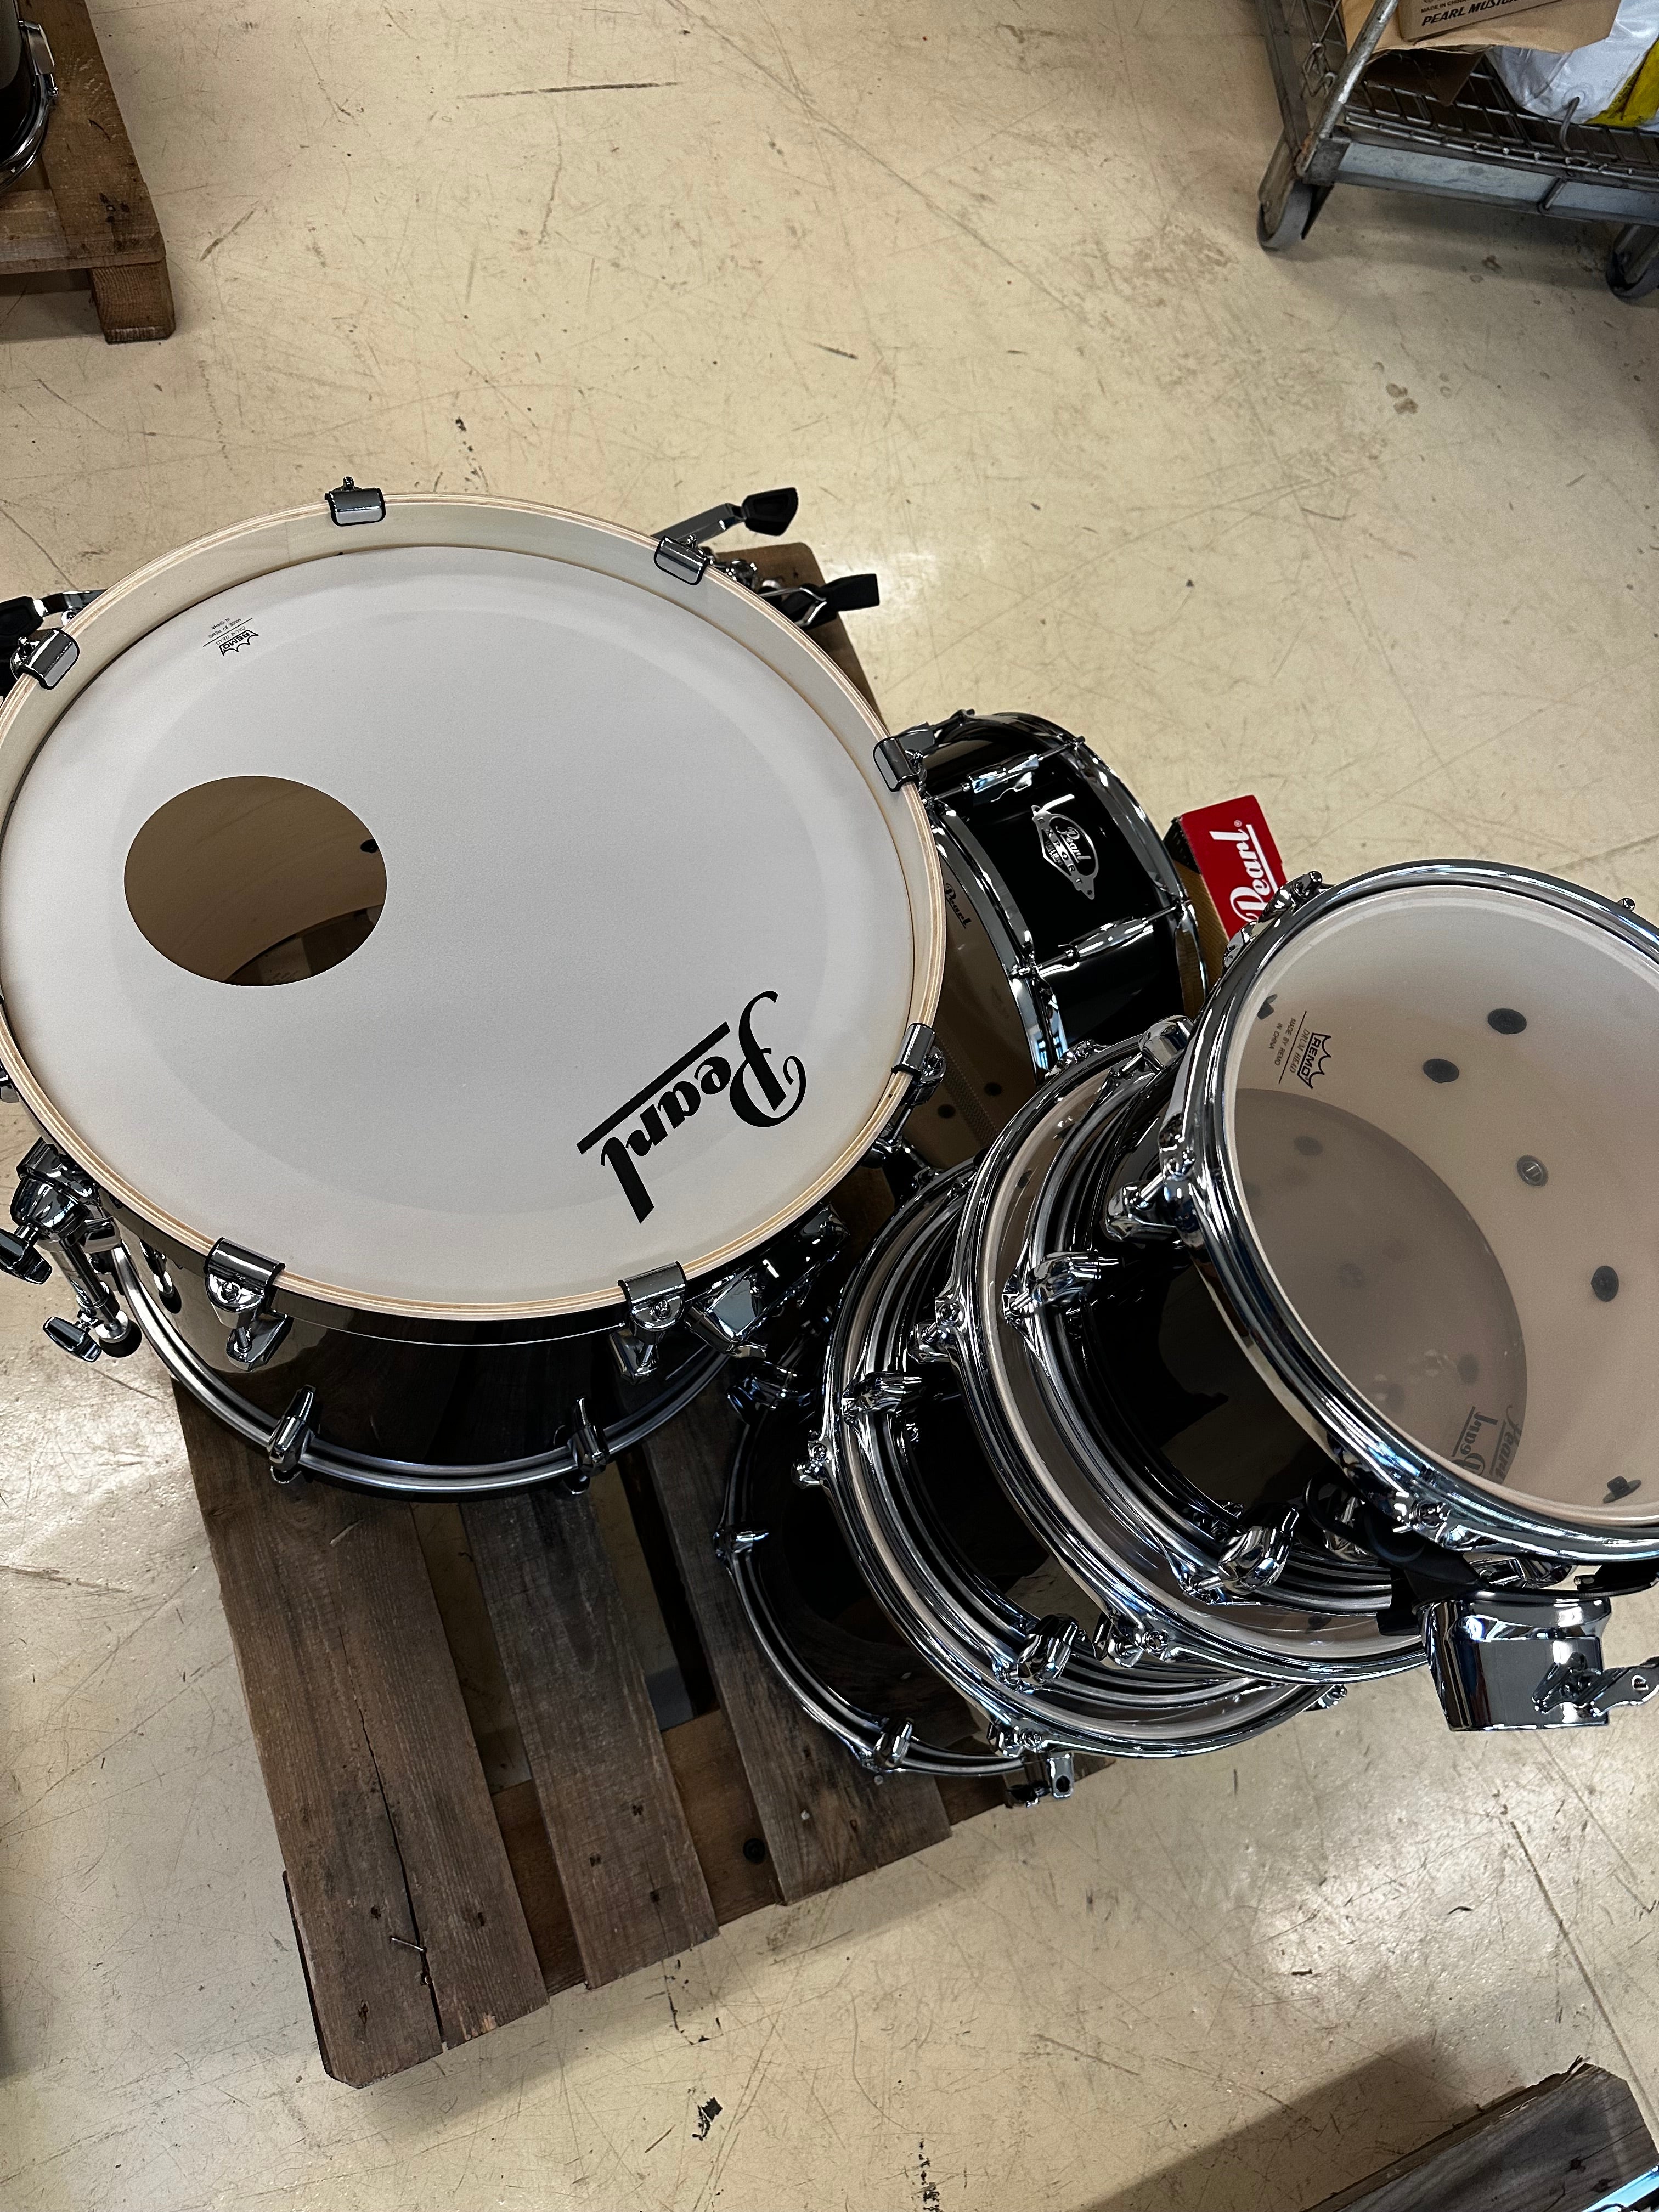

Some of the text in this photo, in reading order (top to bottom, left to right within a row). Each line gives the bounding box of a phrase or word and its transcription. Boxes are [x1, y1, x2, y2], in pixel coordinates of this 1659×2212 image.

[1420, 4, 1438, 13] MADE
[1421, 7, 1466, 26] PEARL
[211, 621, 224, 629] CHINA
[216, 626, 245, 645] DRUM HEAD
[229, 618, 241, 627] MADE
[223, 632, 250, 649] REMO
[1037, 817, 1083, 884] EXPORT
[1055, 826, 1091, 863] Pearl
[944, 883, 972, 929] Pearl
[1268, 1031, 1280, 1049] CHINA
[1274, 1018, 1296, 1065] MADE BY REMO
[1289, 1028, 1310, 1073] DRUM HEAD
[1301, 1037, 1321, 1077] REMO
[577, 990, 806, 1224] Pearl
